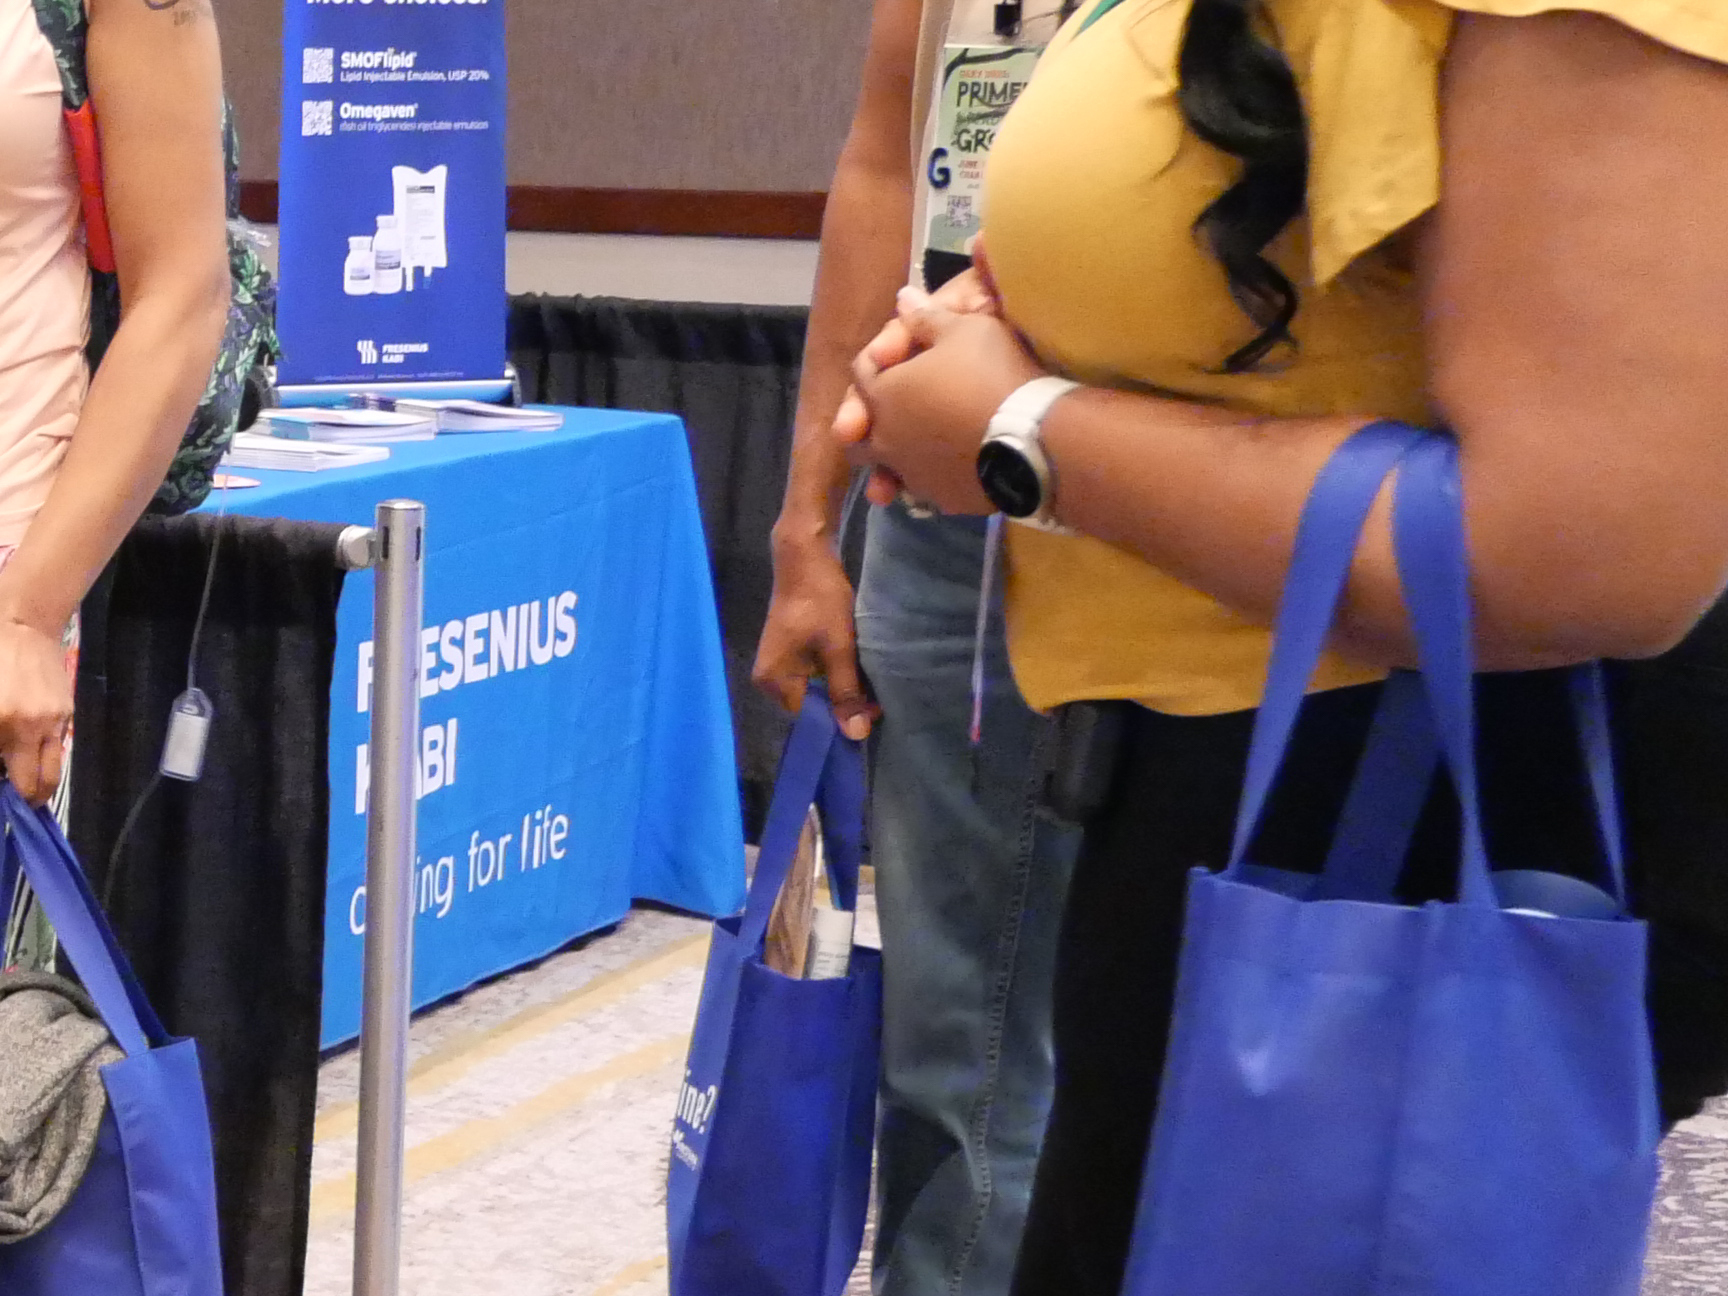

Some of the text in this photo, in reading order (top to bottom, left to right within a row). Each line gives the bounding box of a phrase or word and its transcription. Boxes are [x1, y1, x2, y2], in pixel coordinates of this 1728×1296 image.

[956, 81, 1028, 108] PRIME
[926, 147, 952, 190] G
[356, 590, 579, 713] FESENIUS
[349, 804, 570, 936] cing for life
